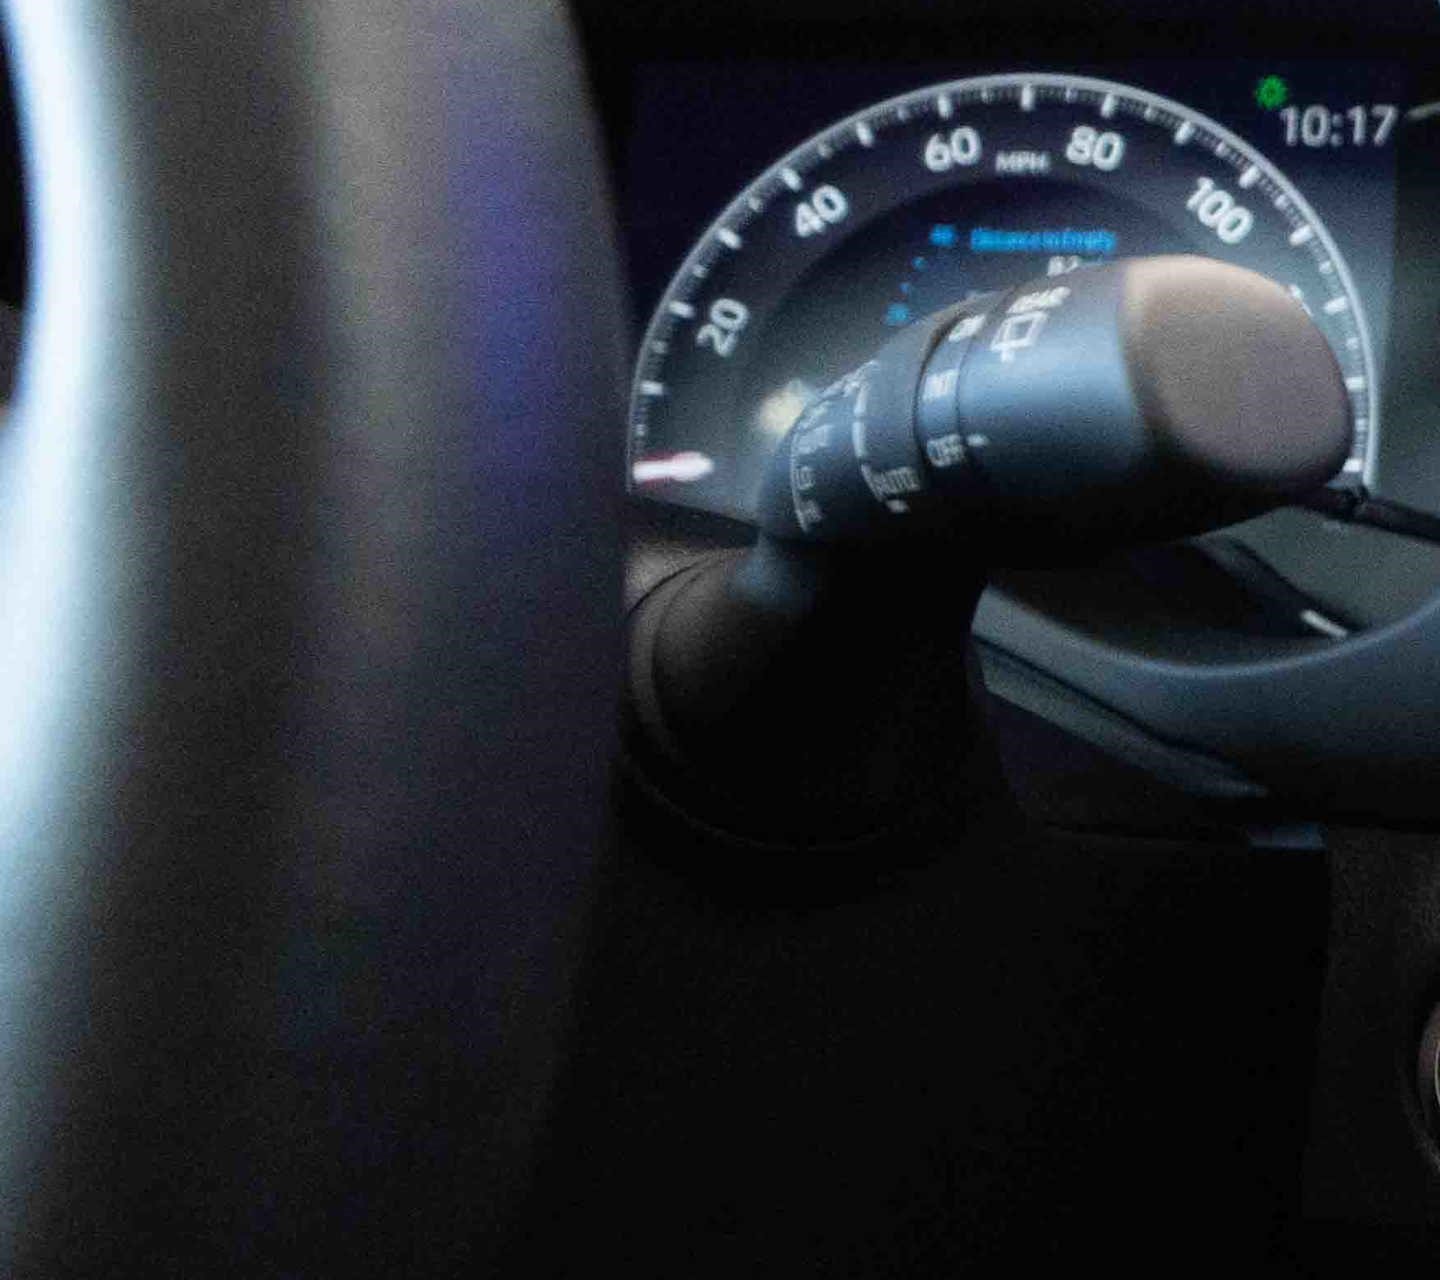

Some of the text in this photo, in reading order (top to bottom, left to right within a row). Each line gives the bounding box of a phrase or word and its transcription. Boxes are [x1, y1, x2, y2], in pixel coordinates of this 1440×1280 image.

[924, 126, 982, 172] 60
[1065, 125, 1125, 172] 80
[1280, 104, 1397, 148] 10:17
[794, 184, 849, 237] 40
[1186, 176, 1255, 245] 100
[695, 297, 751, 358] 20
